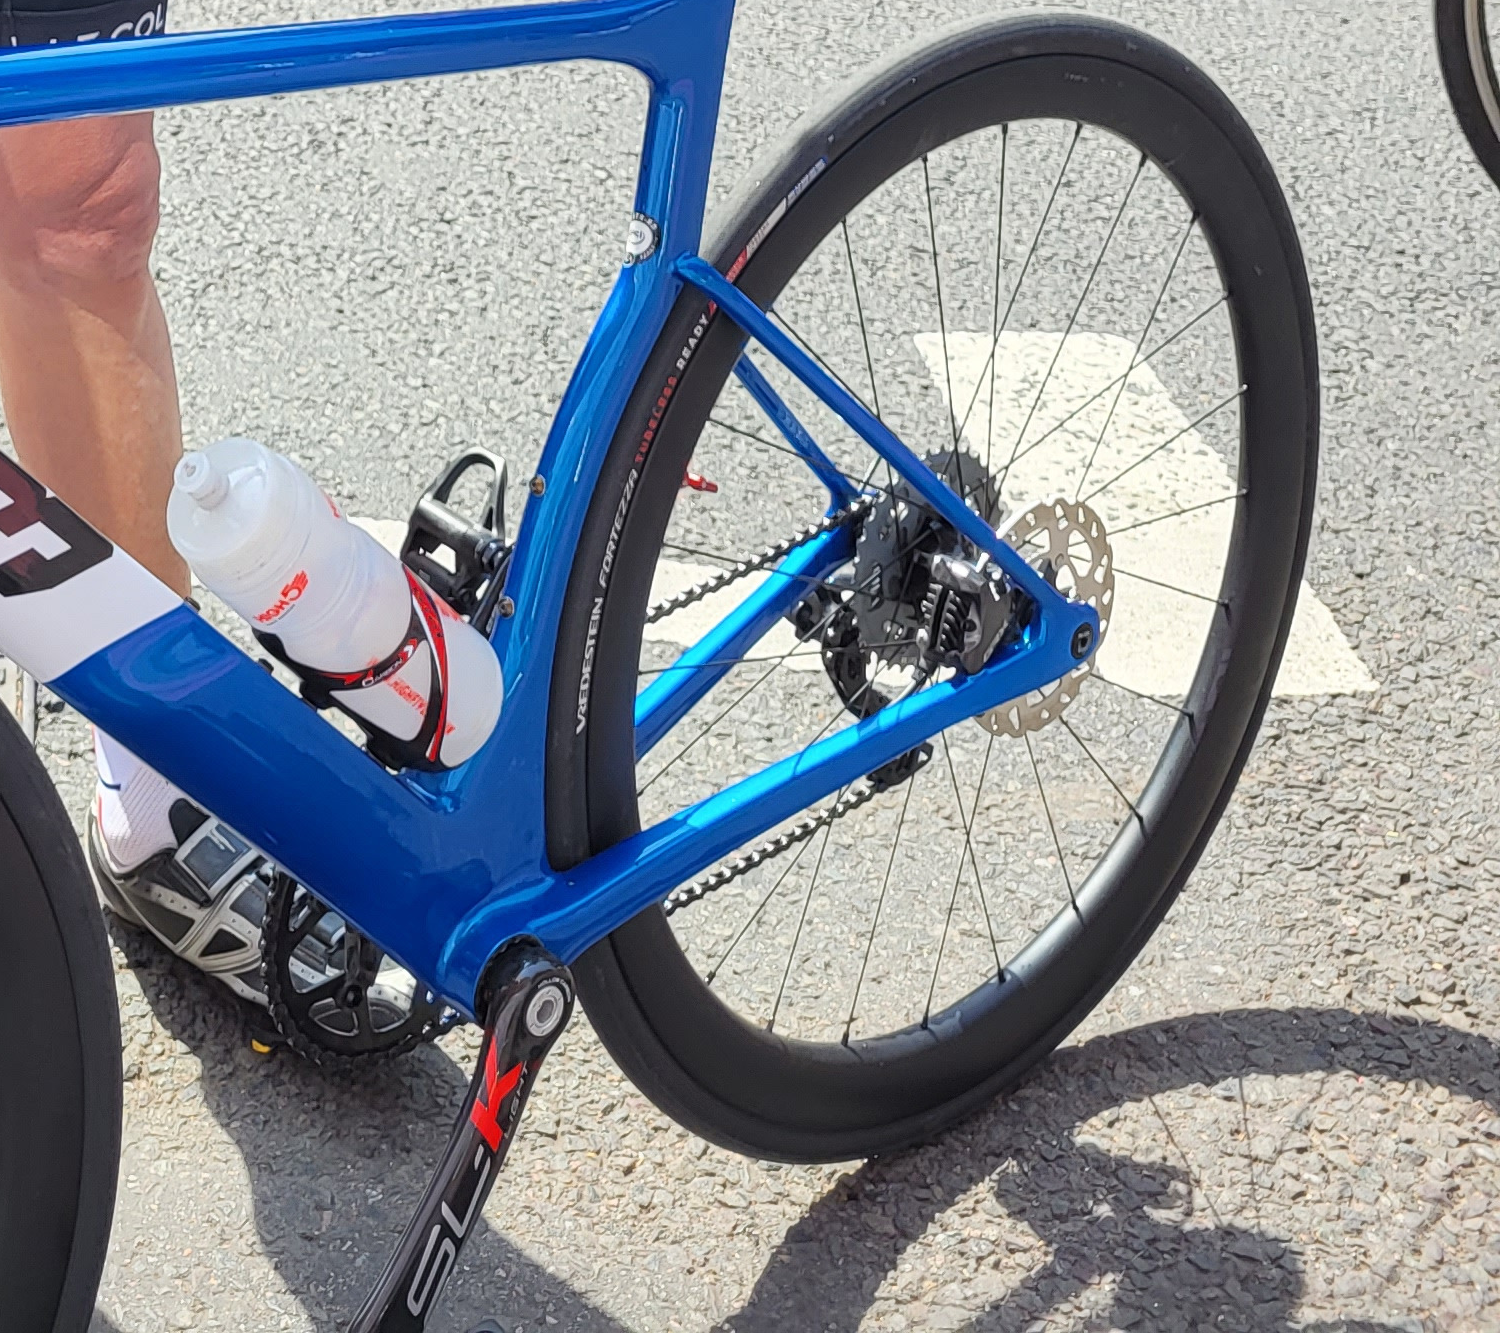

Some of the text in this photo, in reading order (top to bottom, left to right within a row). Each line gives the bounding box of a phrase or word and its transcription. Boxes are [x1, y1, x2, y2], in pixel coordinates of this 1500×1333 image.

[675, 313, 709, 371] READY
[634, 374, 678, 464] TUBELESS
[597, 469, 640, 589] FORTEZZA
[575, 595, 604, 735] VREDESTEIN
